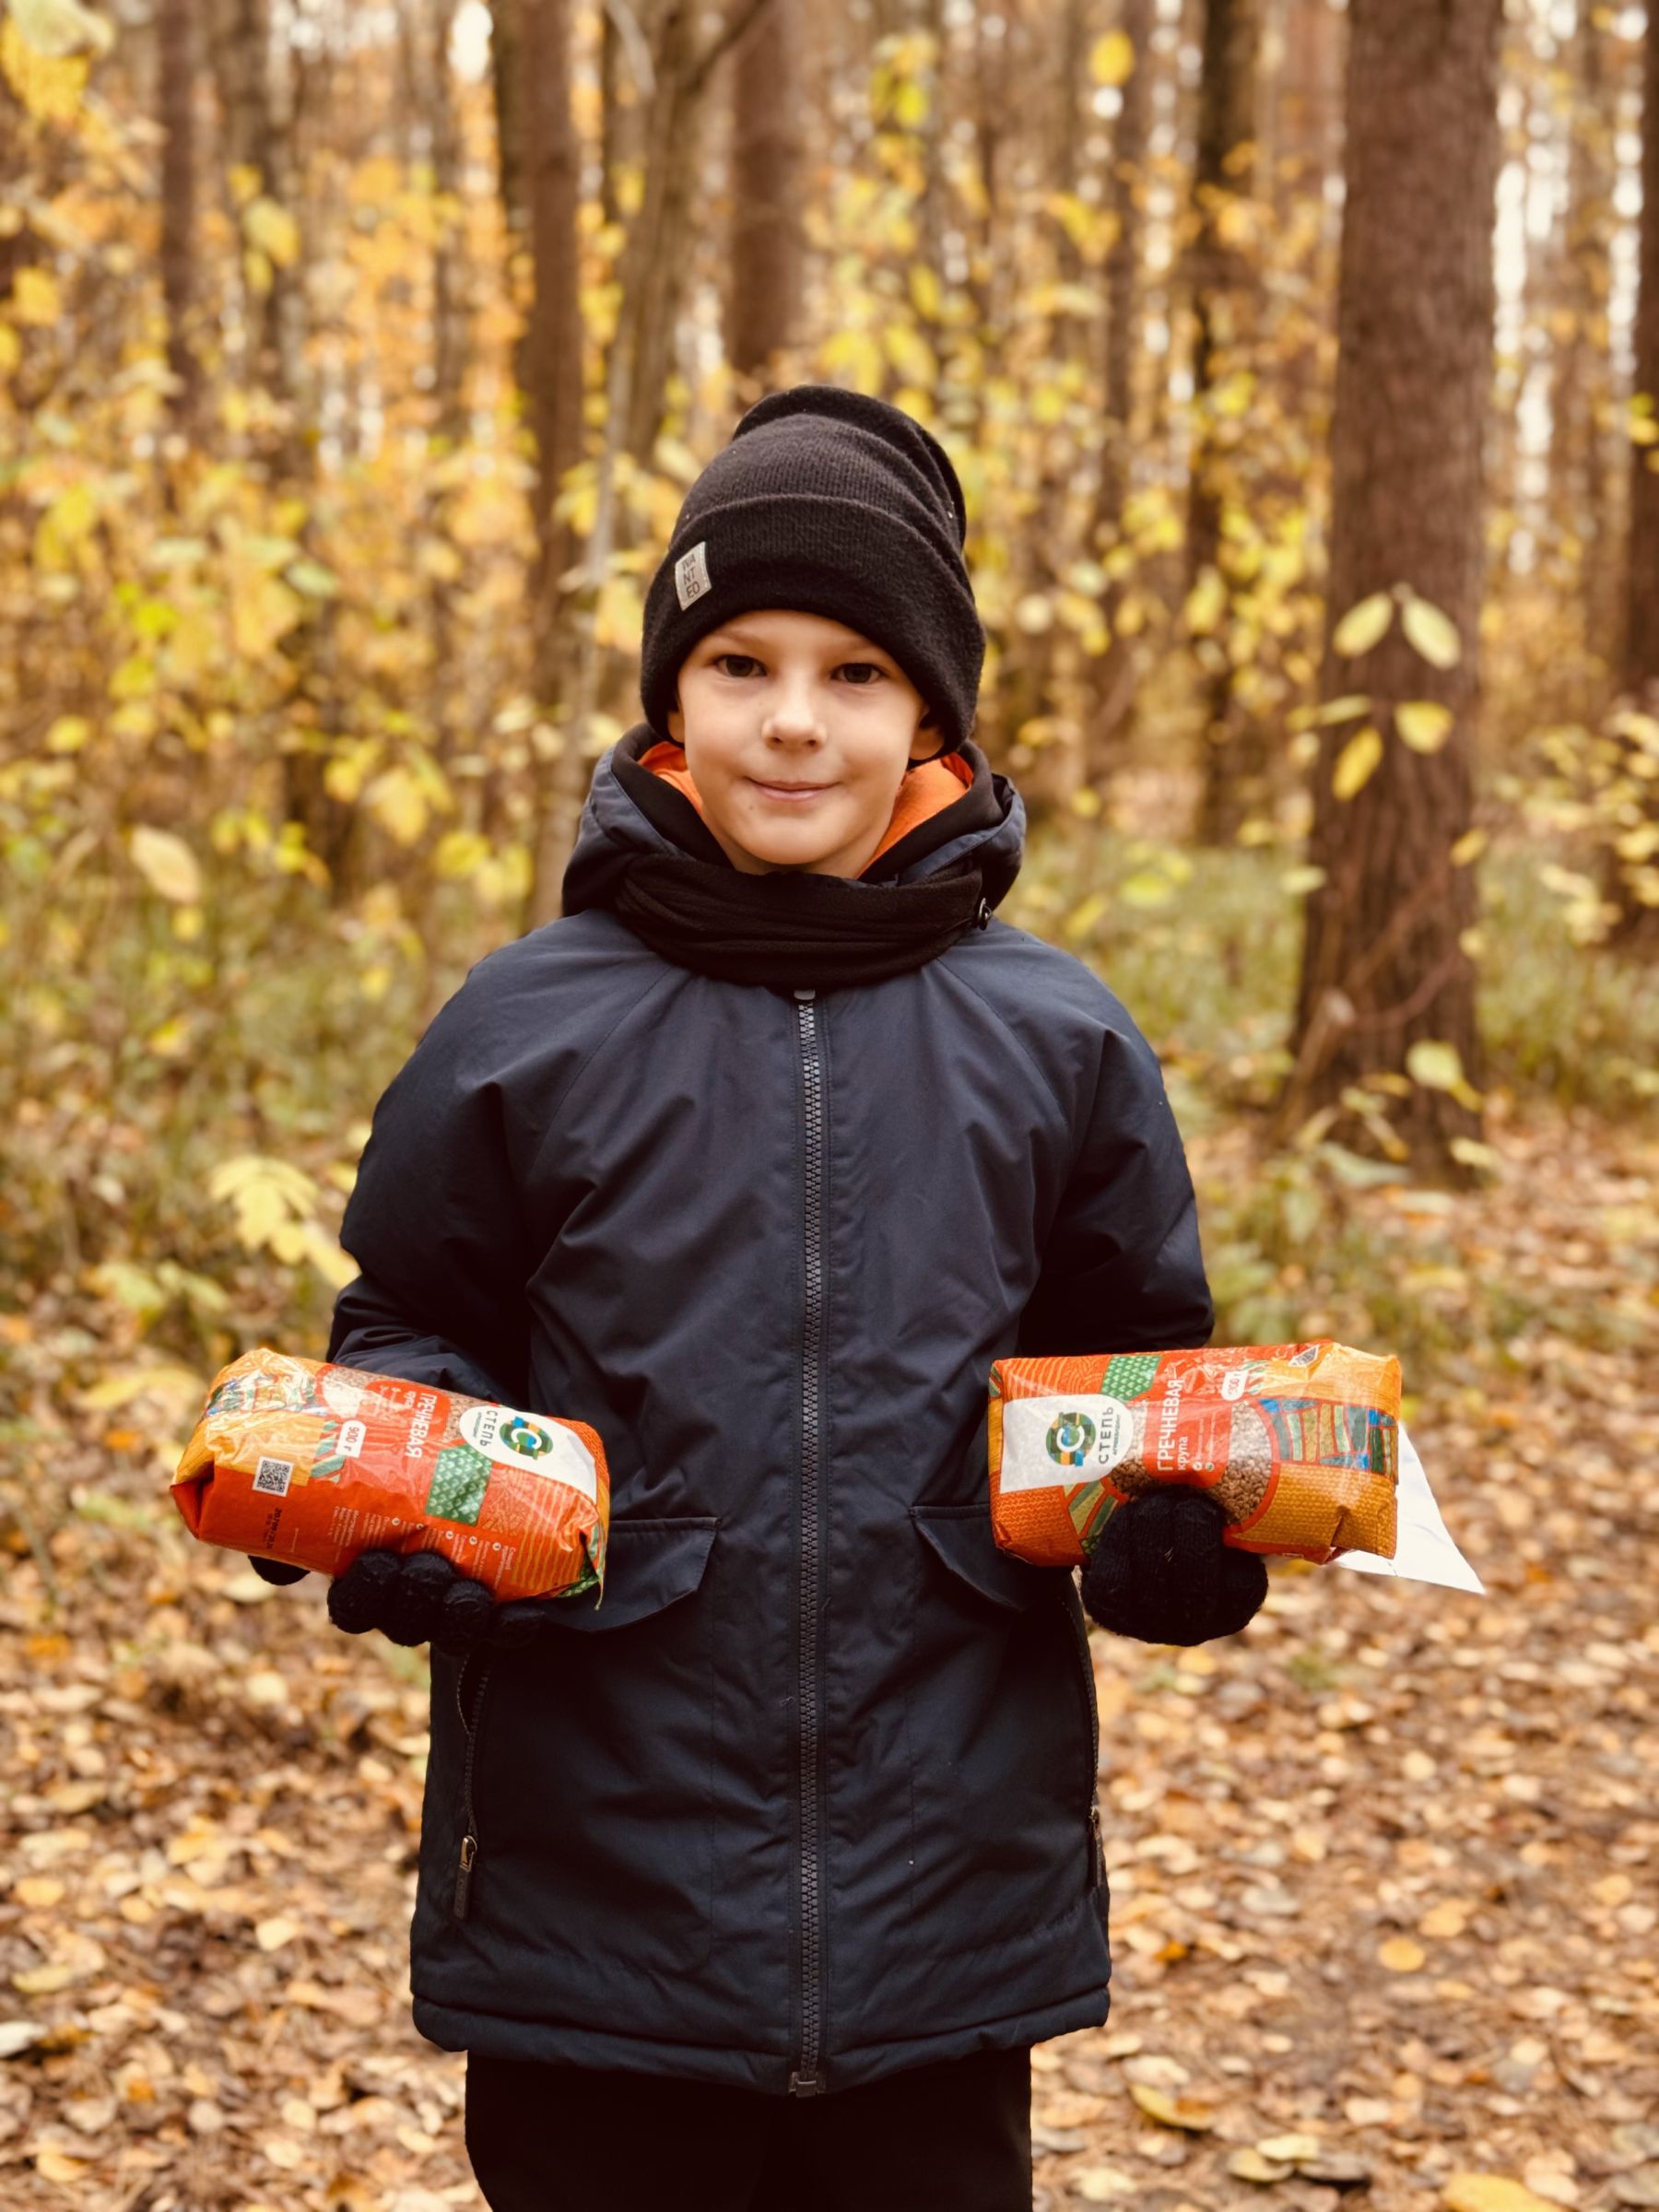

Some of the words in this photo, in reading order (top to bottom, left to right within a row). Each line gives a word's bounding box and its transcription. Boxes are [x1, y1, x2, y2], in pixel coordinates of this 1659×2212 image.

[346, 1426, 360, 1444] 900
[405, 1393, 438, 1458] ГРЕЧНЕВАЯ
[479, 1410, 499, 1447] СТЕПЬ
[1098, 1406, 1113, 1465] СТЕПЬ
[1157, 1379, 1183, 1471] ГРЕЧНЕВАЯ
[1177, 1436, 1190, 1471] крупа
